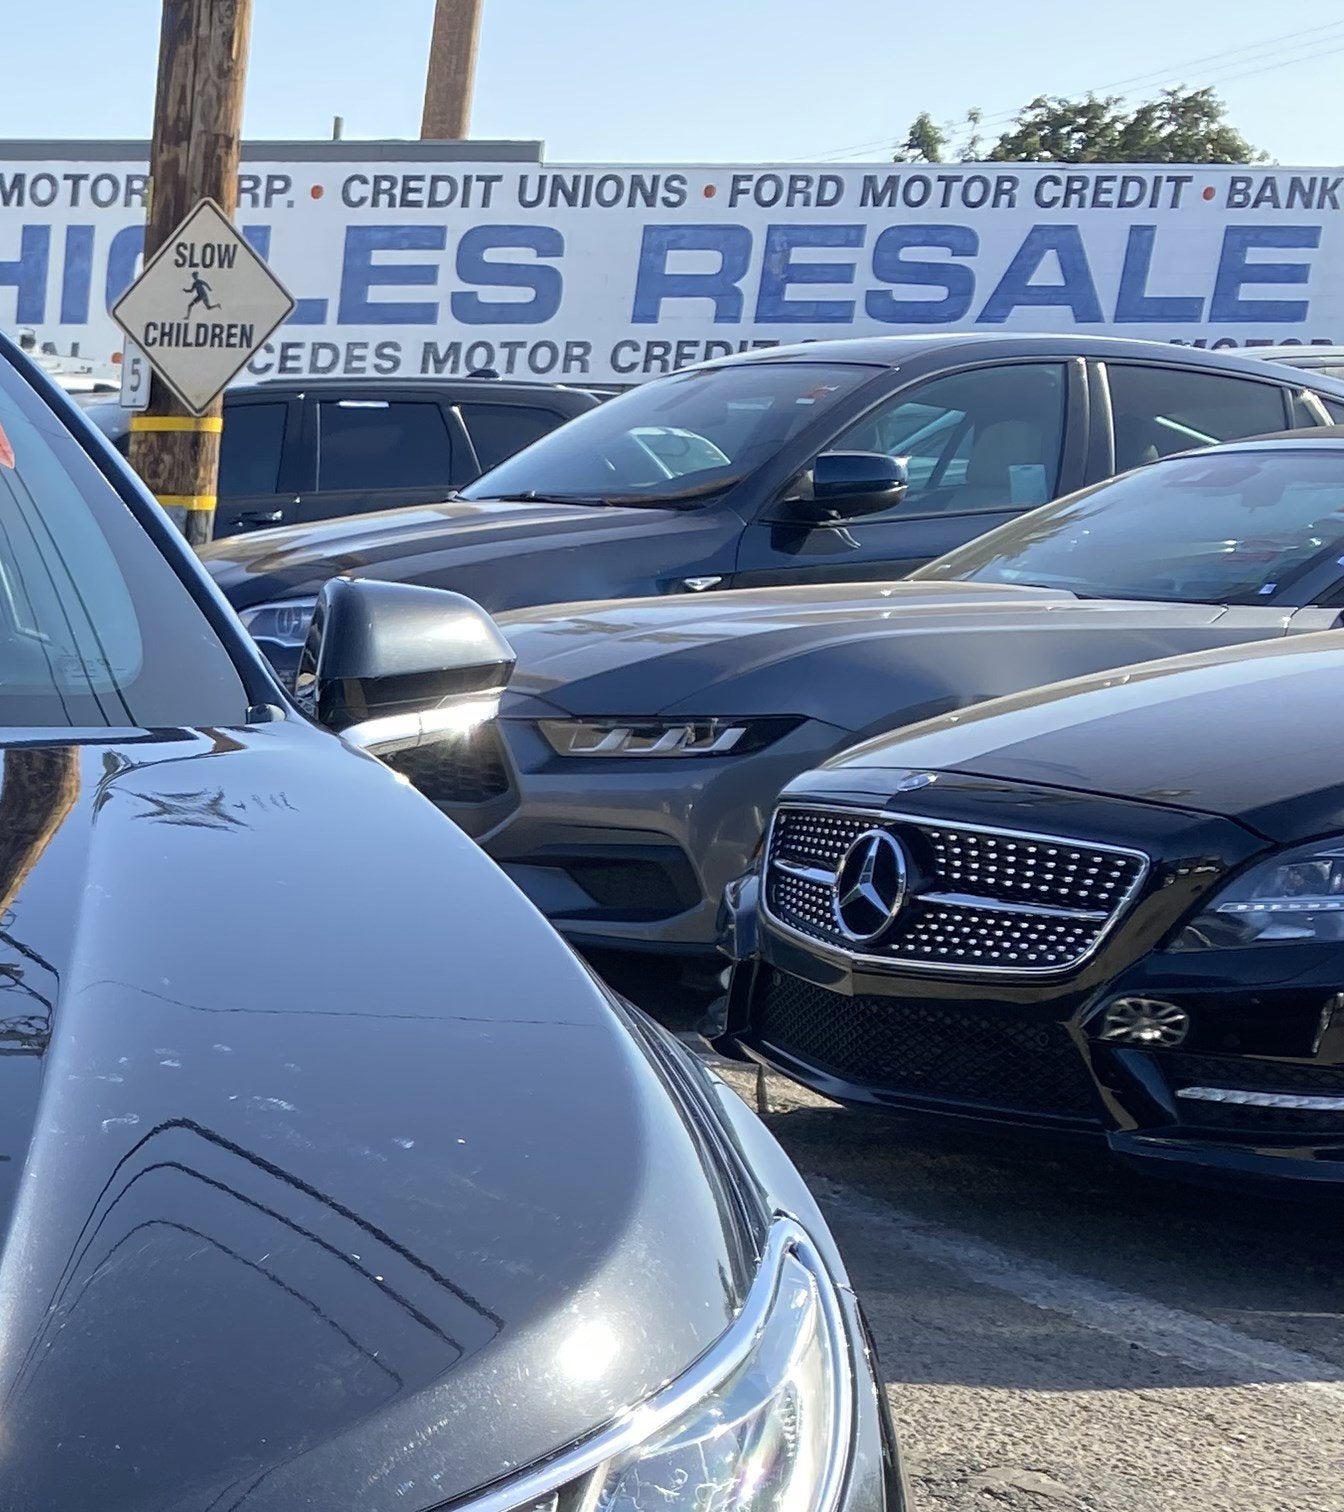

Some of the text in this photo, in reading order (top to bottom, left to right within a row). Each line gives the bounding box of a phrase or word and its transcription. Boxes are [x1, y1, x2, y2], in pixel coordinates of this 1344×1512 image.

[237, 174, 295, 209] RP.
[340, 173, 505, 209] CREDIT
[516, 173, 689, 210] UNIONS
[727, 173, 846, 210] FORD
[859, 173, 1020, 210] MOTOR
[1032, 174, 1194, 210] CREDIT
[1225, 175, 1344, 210] BANK
[173, 241, 239, 269] SLOW
[629, 223, 1323, 326] RESALE
[143, 321, 255, 349] CHILDREN
[246, 340, 780, 376] CEDES MOTOR CRED
